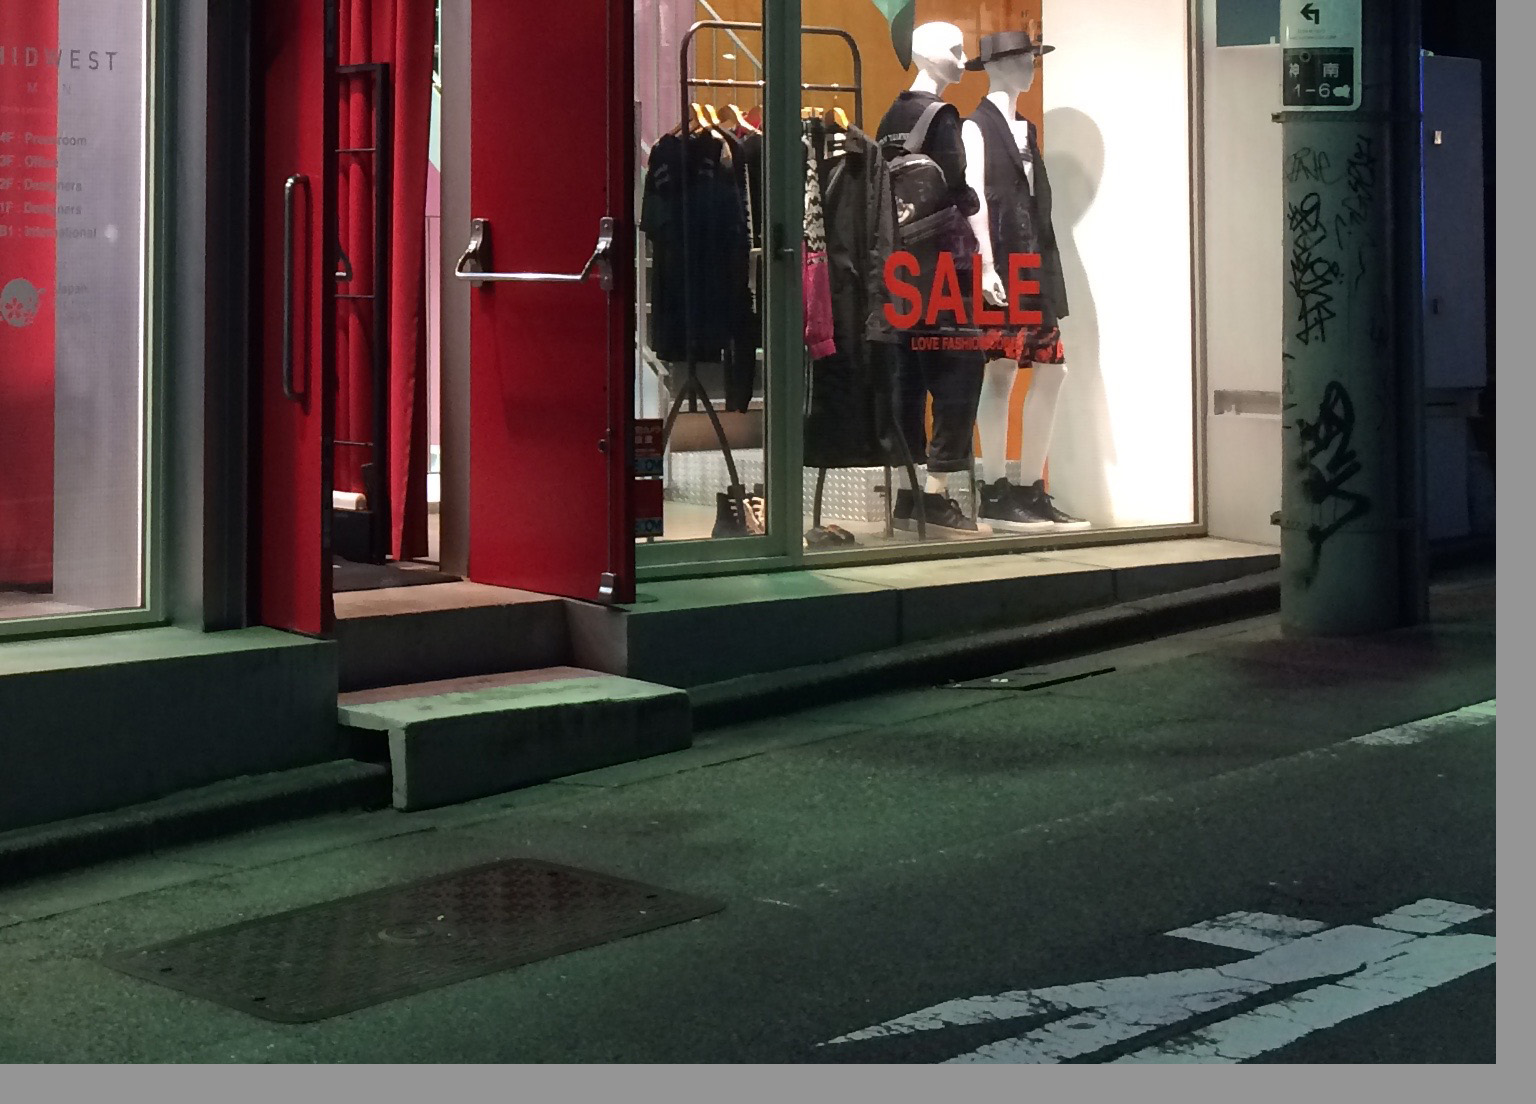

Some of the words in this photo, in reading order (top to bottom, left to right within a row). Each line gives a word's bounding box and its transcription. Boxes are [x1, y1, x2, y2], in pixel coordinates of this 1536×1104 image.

[883, 251, 1043, 329] SALE
[911, 336, 940, 351] LOVE
[942, 336, 985, 351] FASHIO
